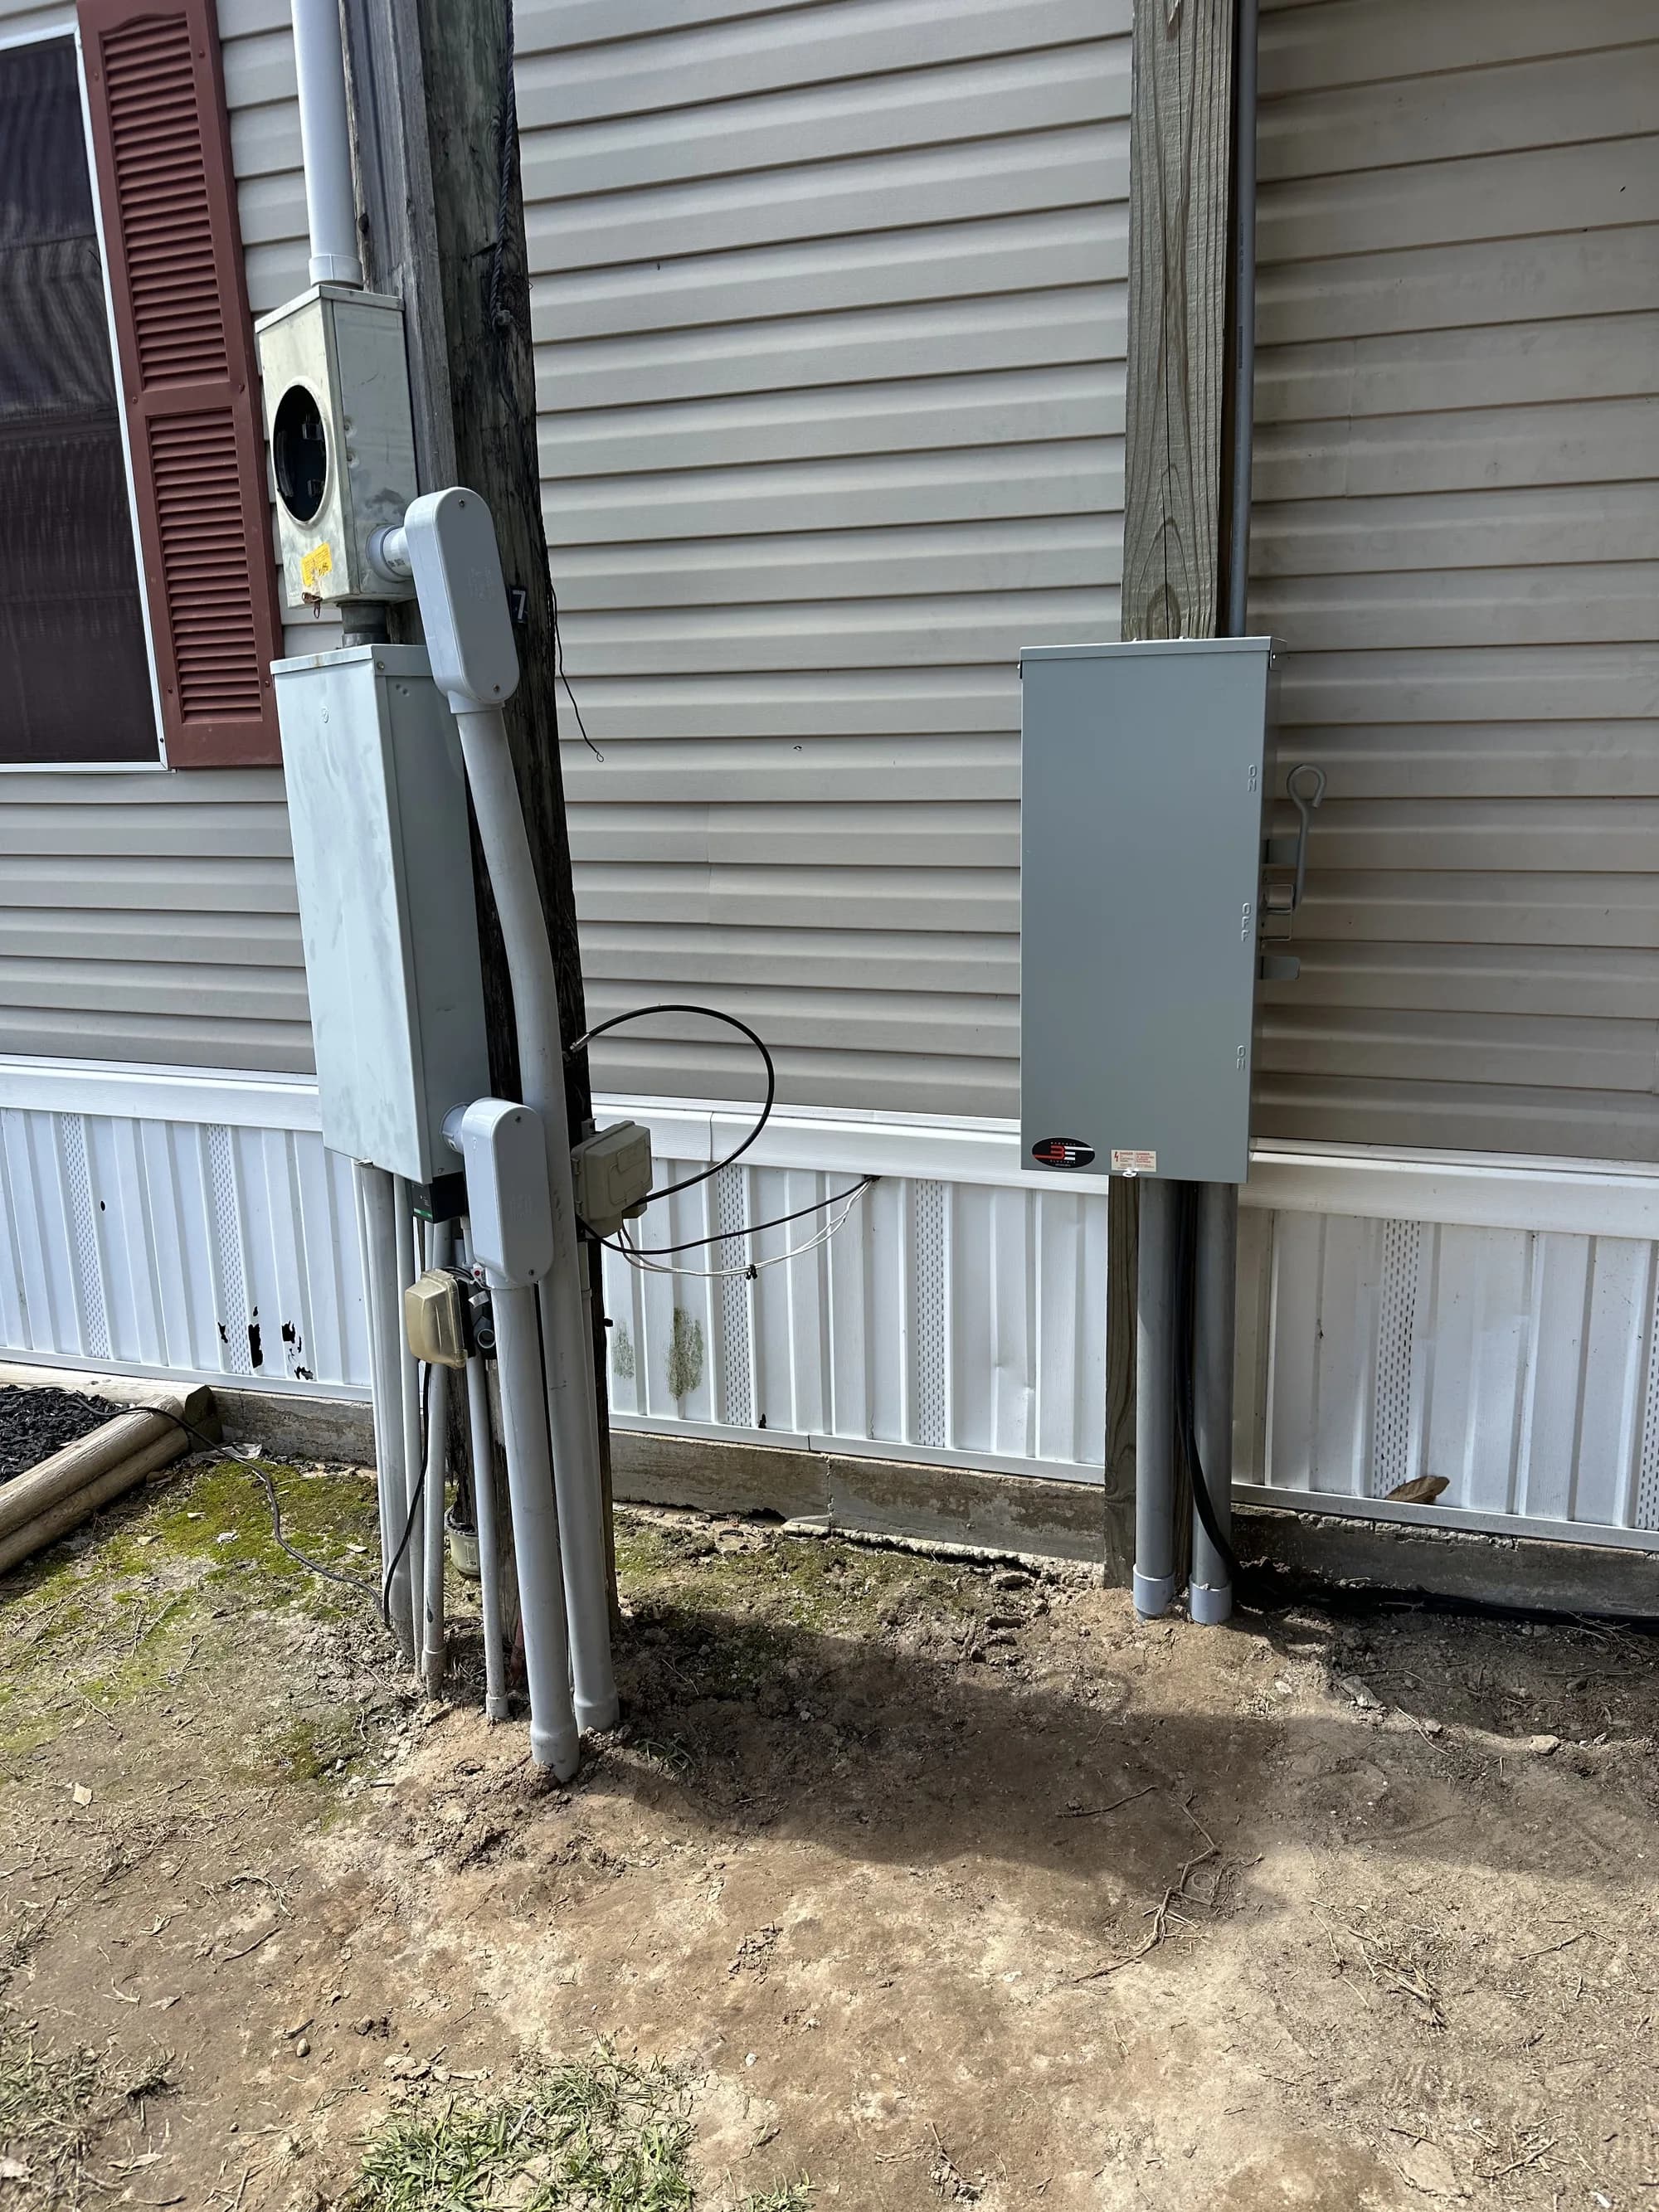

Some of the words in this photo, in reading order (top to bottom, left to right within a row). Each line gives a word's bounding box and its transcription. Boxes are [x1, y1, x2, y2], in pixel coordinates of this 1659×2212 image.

[512, 590, 526, 620] 7
[1248, 764, 1258, 792] ON
[1241, 902, 1252, 942] OFF
[1236, 1045, 1246, 1071] ON
